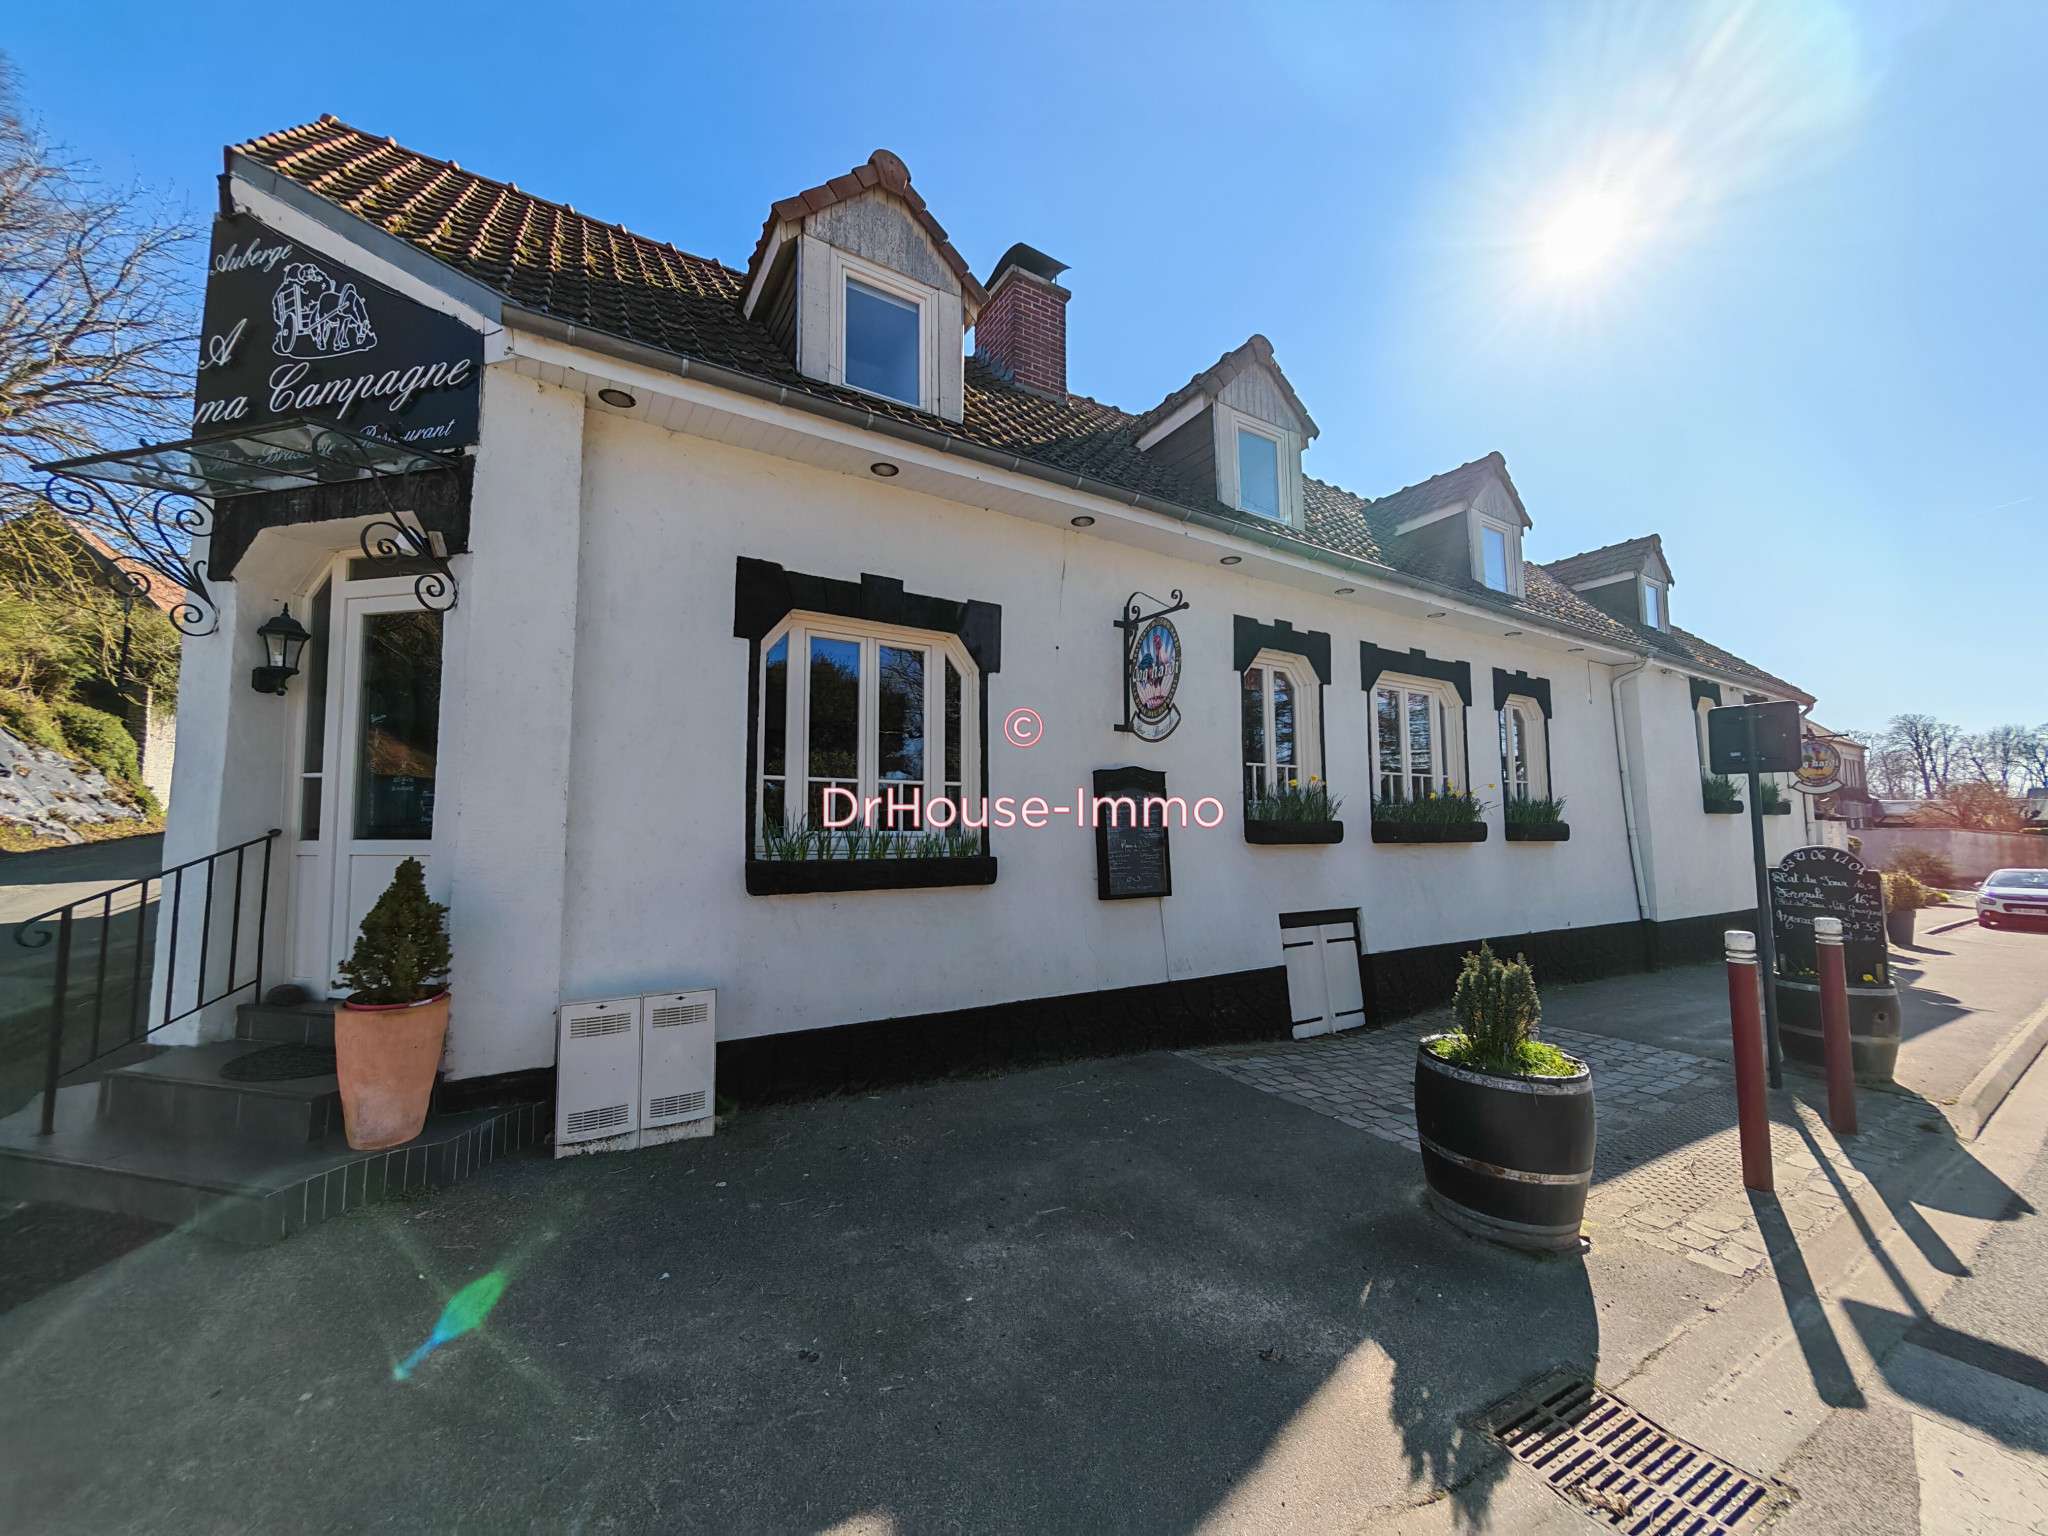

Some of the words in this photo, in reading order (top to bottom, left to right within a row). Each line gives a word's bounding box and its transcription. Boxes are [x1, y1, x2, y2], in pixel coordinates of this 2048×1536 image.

[213, 238, 293, 273] Auberge
[199, 318, 248, 370] A
[193, 396, 249, 424] ma
[268, 358, 472, 419] Campagne
